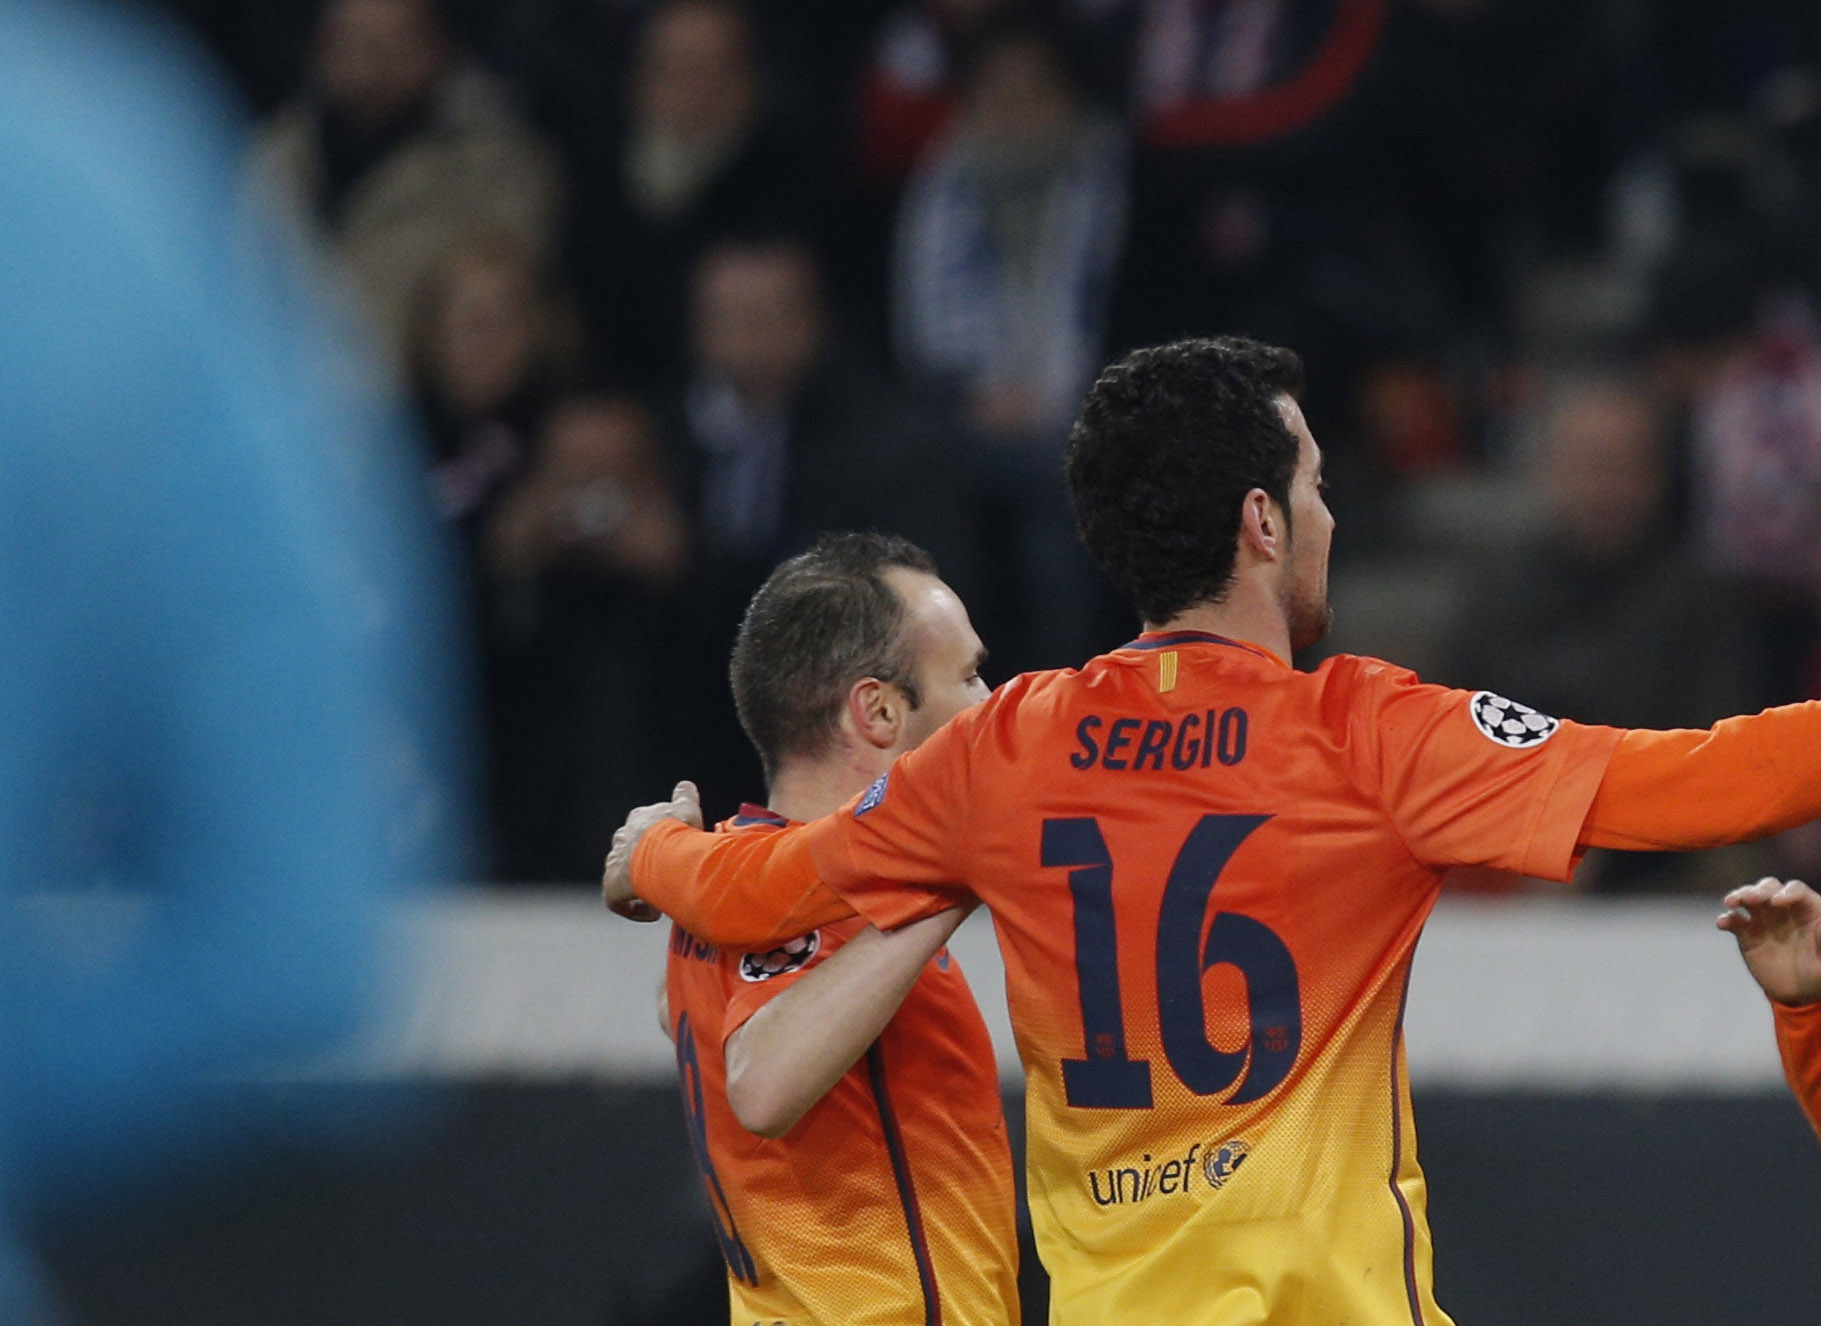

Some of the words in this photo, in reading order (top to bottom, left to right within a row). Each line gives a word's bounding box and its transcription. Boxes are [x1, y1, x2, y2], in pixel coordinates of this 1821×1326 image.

[1070, 707, 1248, 771] SERGIO
[1041, 814, 1302, 1110] 16
[1089, 1143, 1201, 1206] unicef
